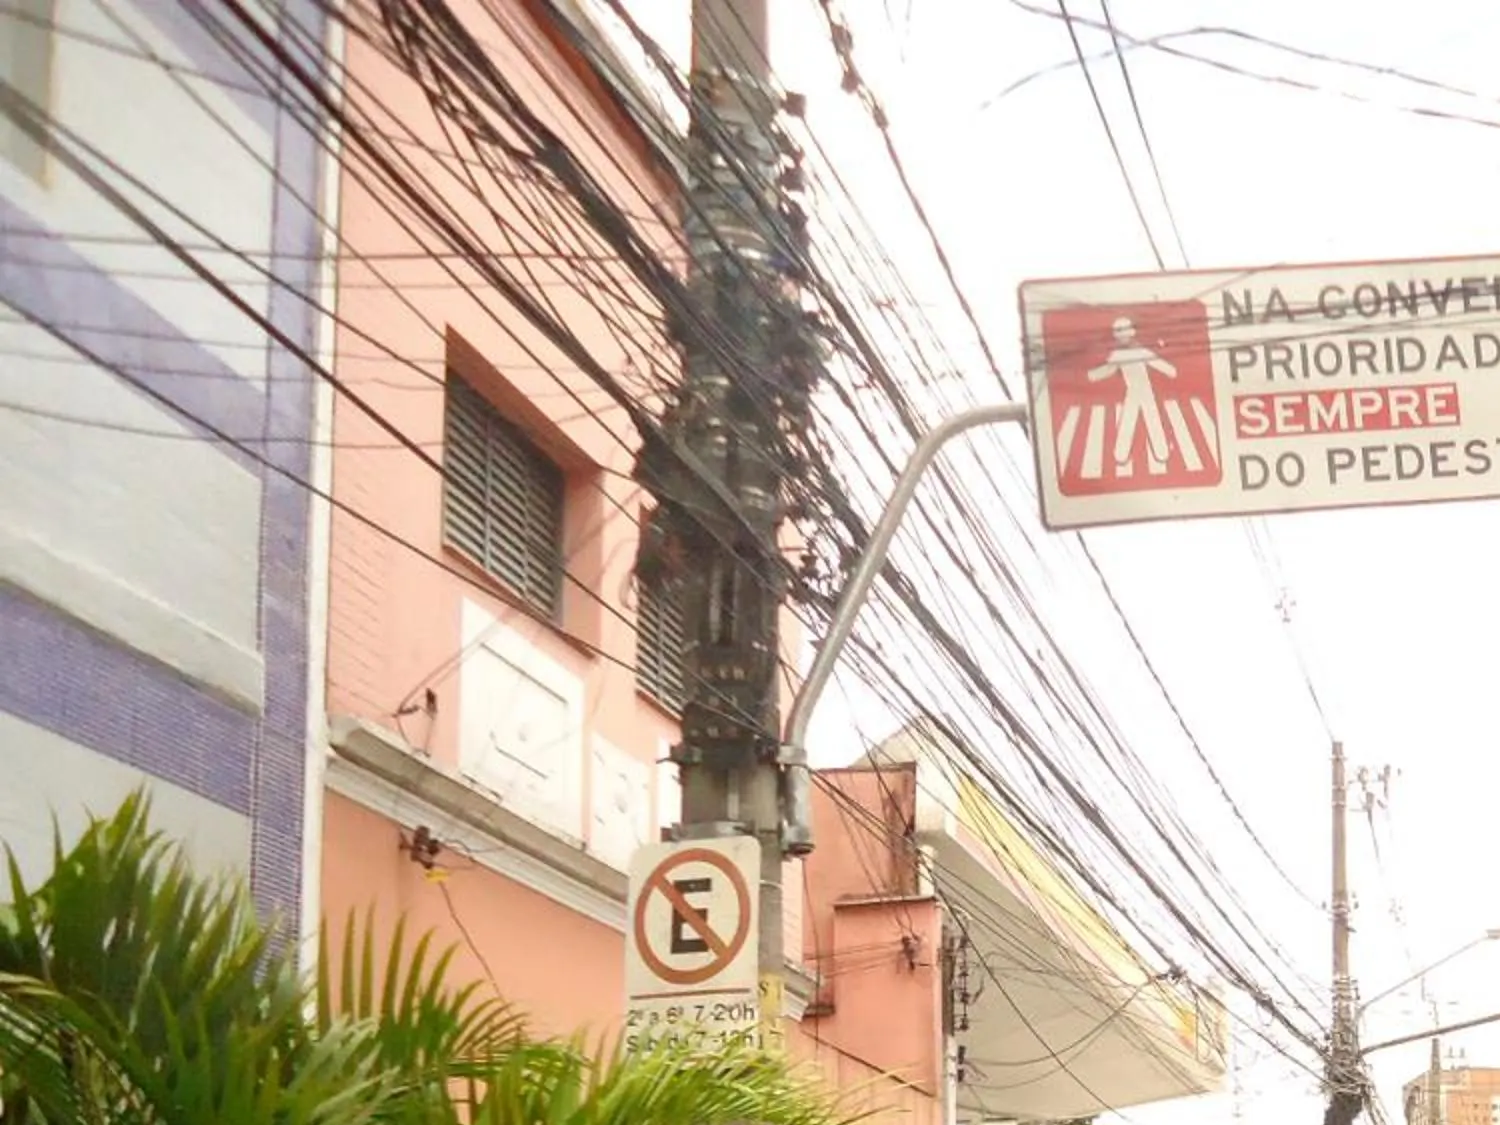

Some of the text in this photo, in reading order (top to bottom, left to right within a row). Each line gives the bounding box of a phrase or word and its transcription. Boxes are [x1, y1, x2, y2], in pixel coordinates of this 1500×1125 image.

[1222, 286, 1294, 326] NA
[1238, 385, 1458, 436] SEMPRE
[1239, 452, 1305, 491] DO
